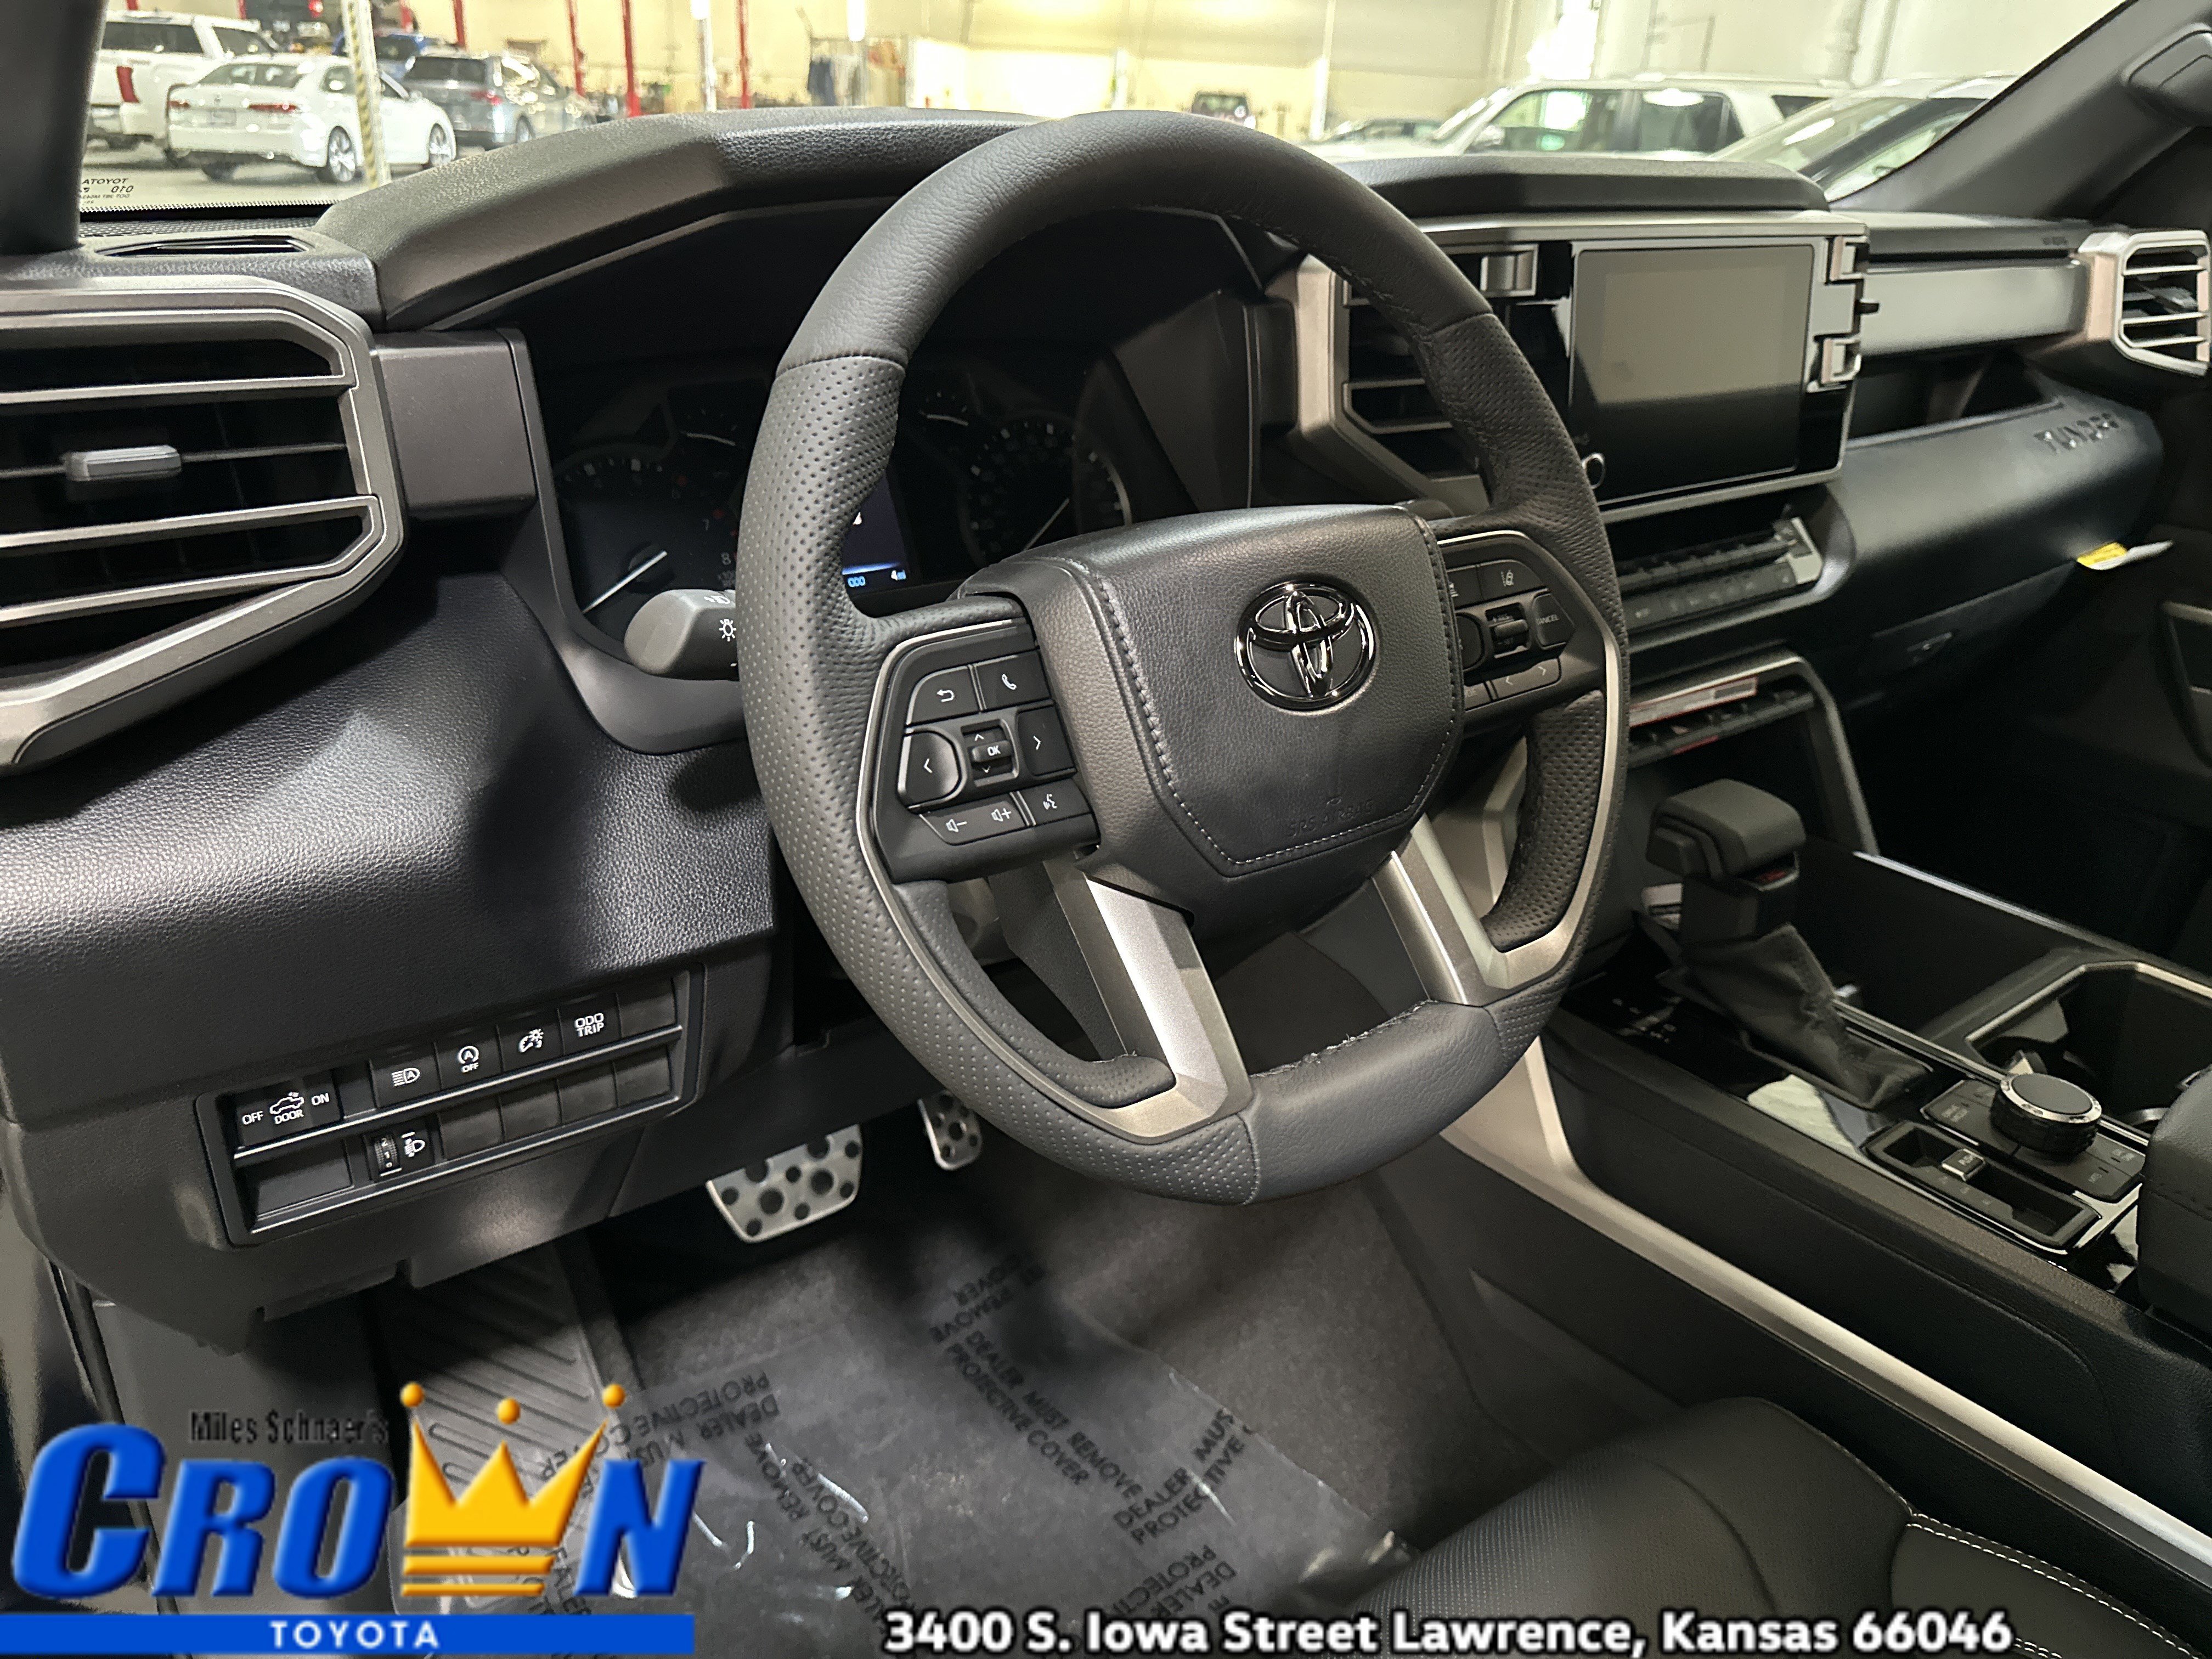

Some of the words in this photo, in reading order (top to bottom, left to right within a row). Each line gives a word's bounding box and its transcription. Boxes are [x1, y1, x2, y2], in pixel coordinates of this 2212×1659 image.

[987, 744, 1001, 757] OK
[574, 1013, 604, 1029] ODO
[575, 1022, 605, 1037] TRIP
[461, 1062, 479, 1074] OFF
[311, 1092, 330, 1106] ON
[242, 1110, 264, 1125] OFF
[274, 1109, 304, 1125] DOOR
[634, 1370, 770, 1436] PROTECTIVE
[699, 1393, 780, 1441] DEALER
[1022, 1390, 1071, 1431] MUST
[1066, 1431, 1144, 1499] REMOVE
[1027, 1429, 1091, 1486] COVER
[1113, 1466, 1190, 1530] DEALER
